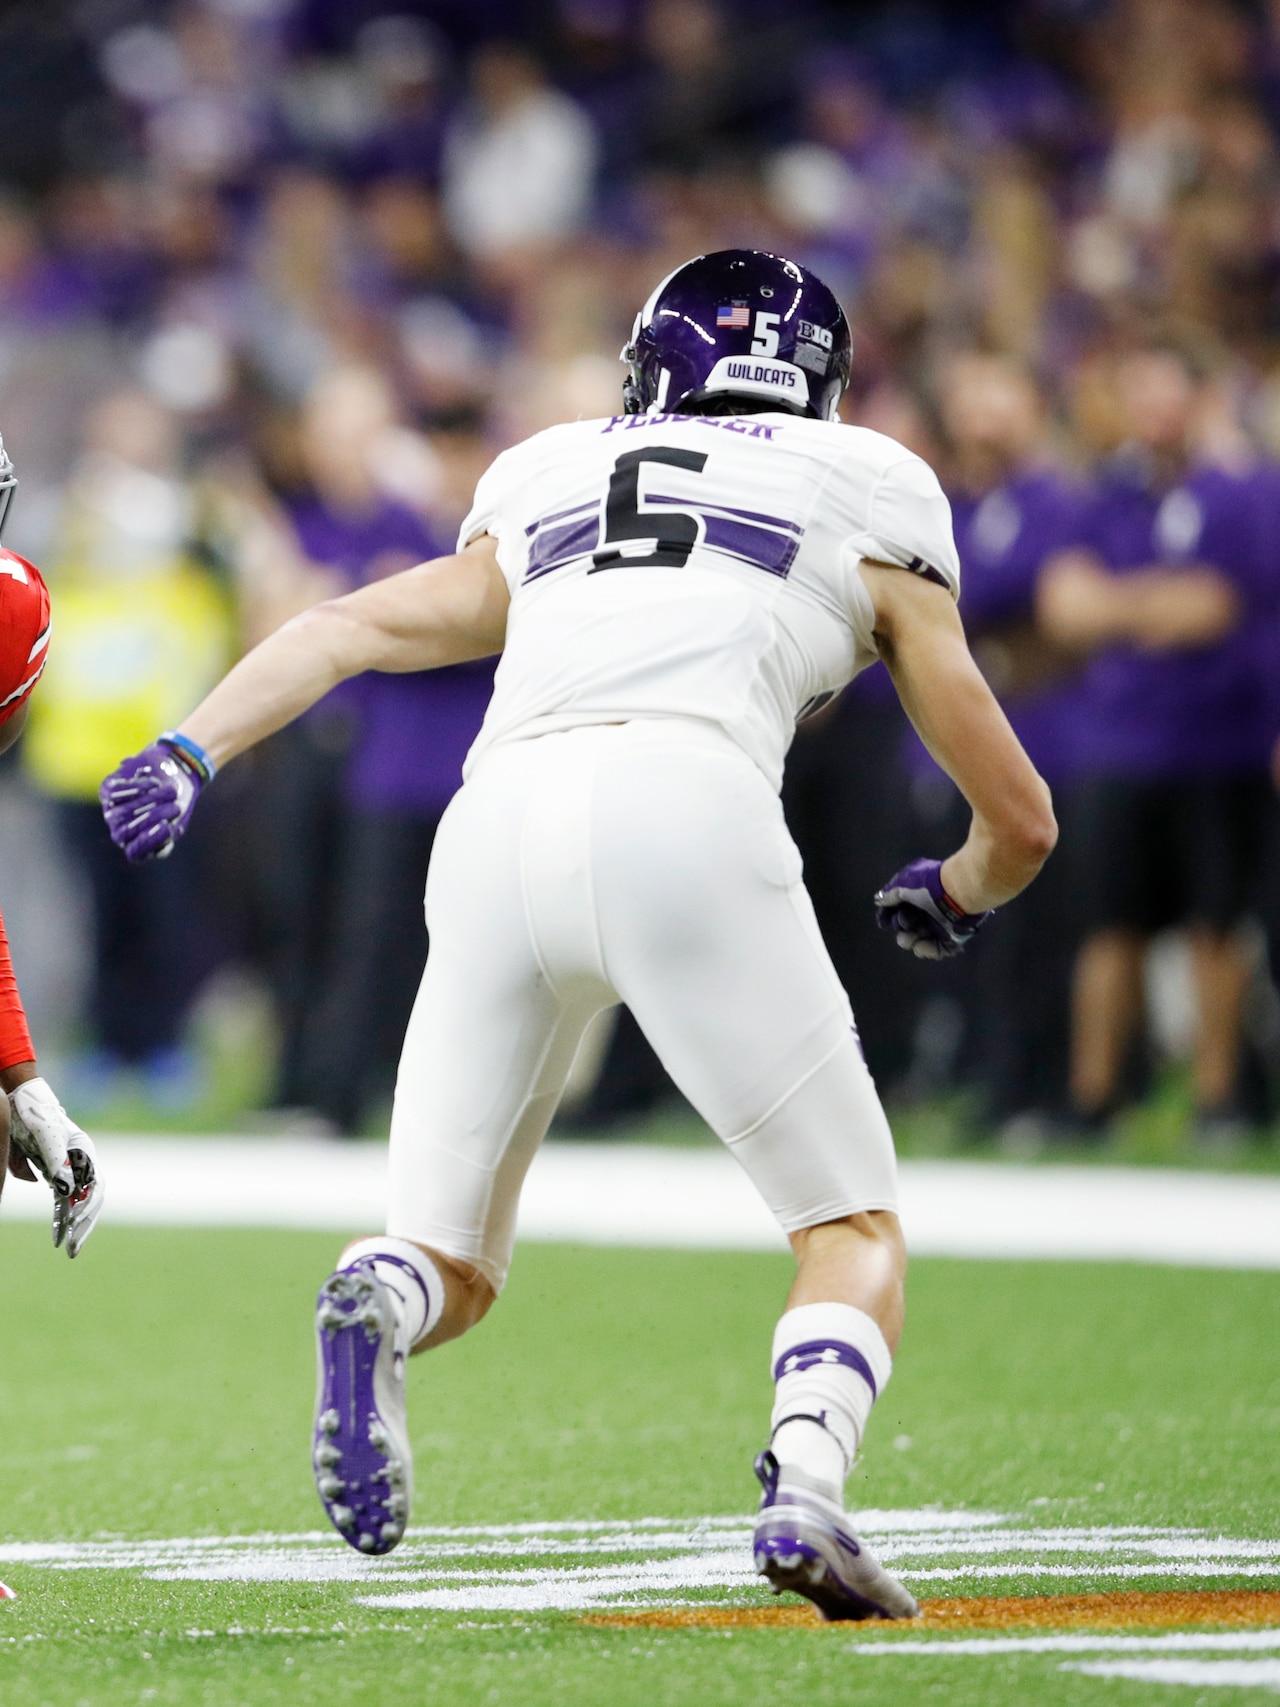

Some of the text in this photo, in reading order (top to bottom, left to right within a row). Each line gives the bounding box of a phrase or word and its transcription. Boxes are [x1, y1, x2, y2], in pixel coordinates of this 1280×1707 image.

[750, 311, 780, 358] 5
[727, 362, 796, 387] WILDCATS
[587, 446, 709, 576] 5
